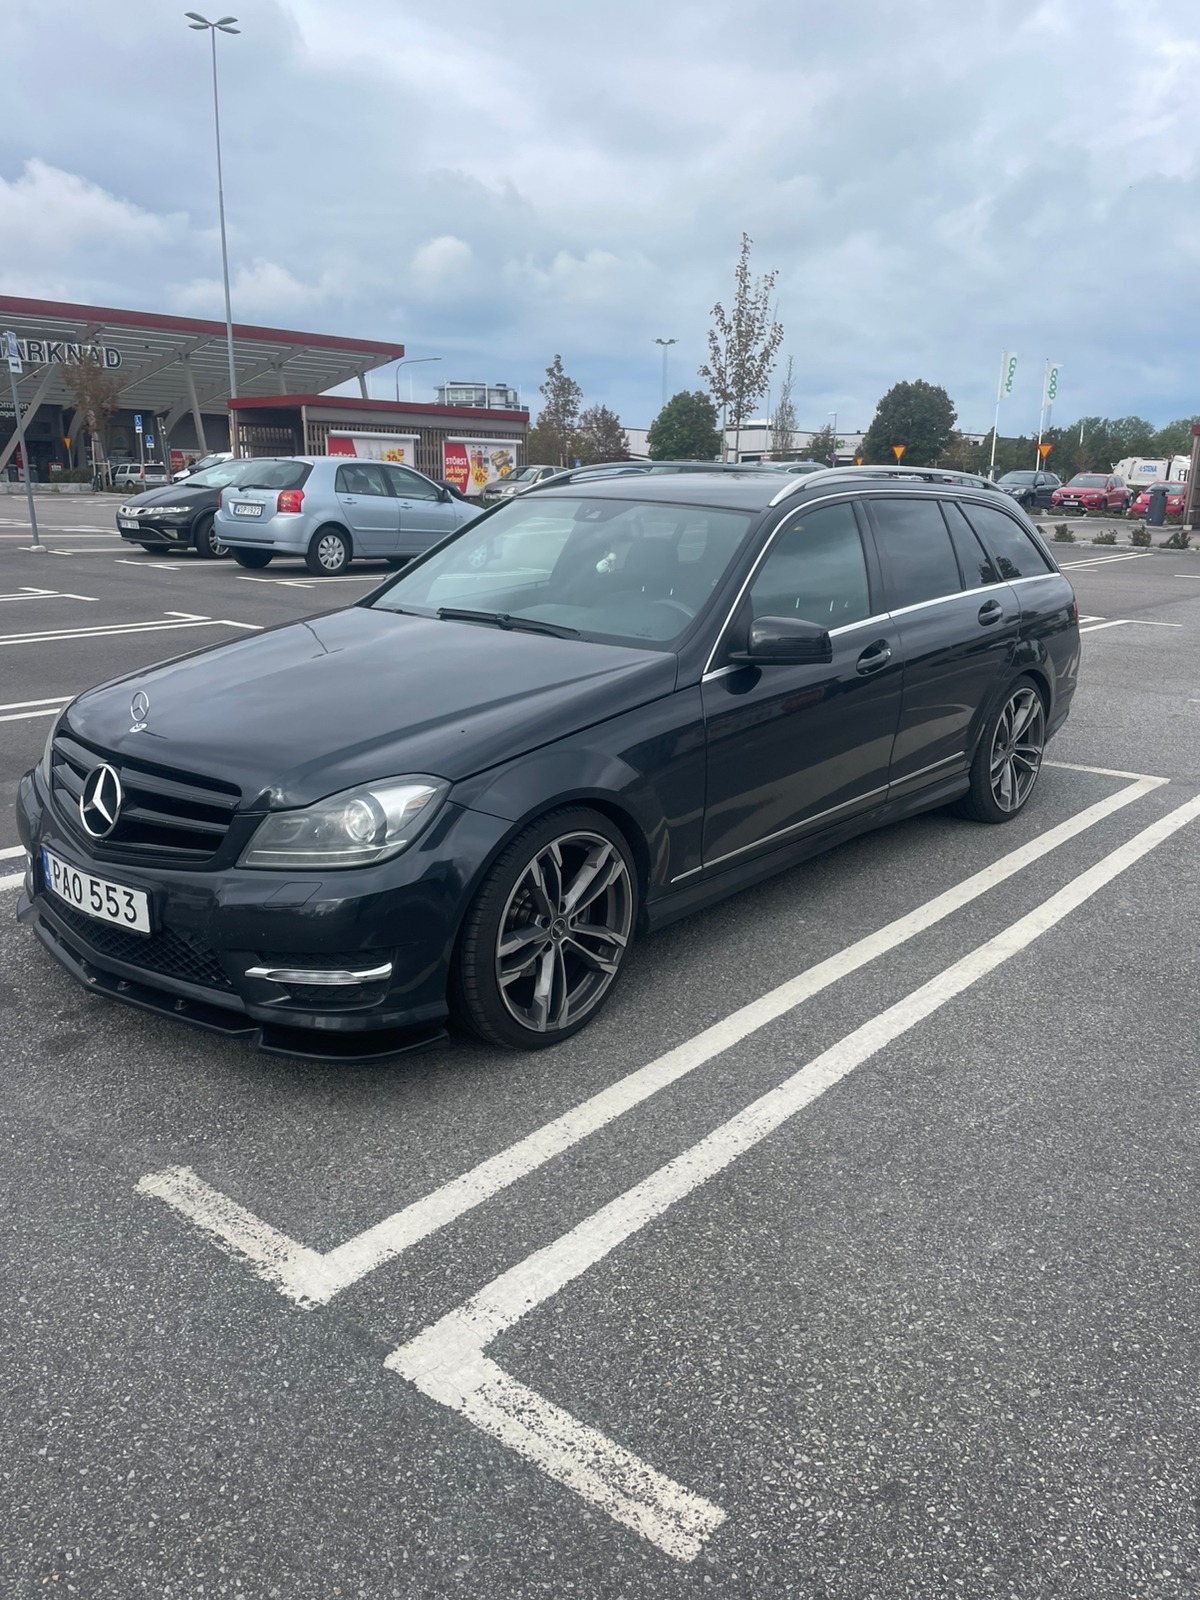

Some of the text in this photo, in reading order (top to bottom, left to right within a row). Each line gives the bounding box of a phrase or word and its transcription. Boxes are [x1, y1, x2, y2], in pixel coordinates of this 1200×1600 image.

[1047, 368, 1059, 400] coop
[445, 456, 467, 465] STÖRST
[446, 466, 468, 475] på låga
[52, 859, 137, 923] PAO 553
